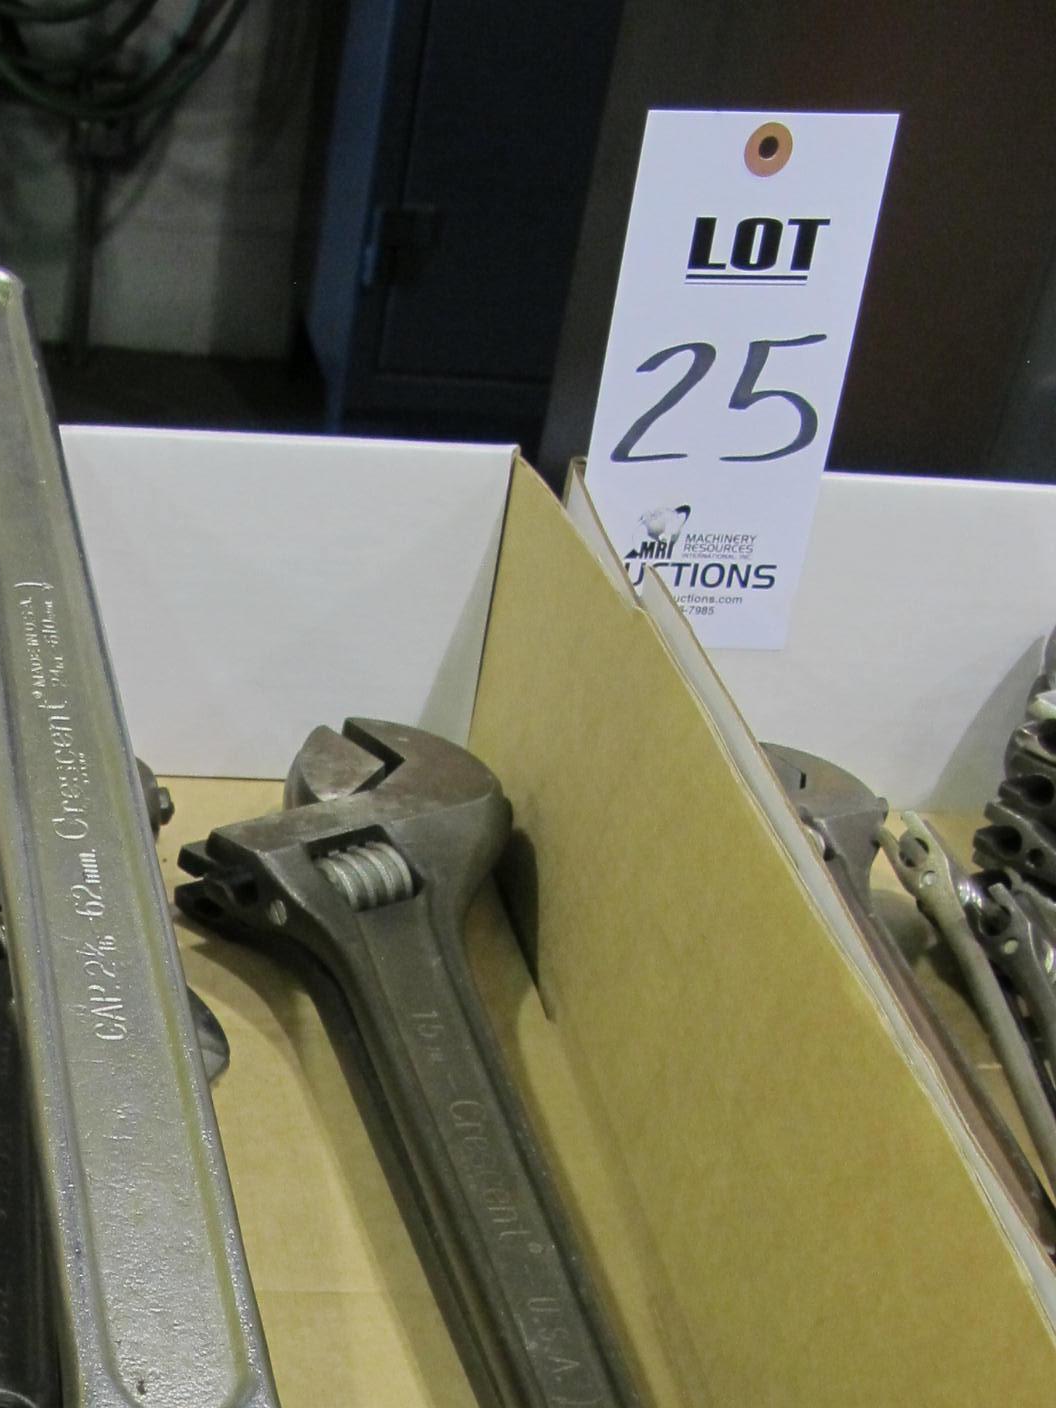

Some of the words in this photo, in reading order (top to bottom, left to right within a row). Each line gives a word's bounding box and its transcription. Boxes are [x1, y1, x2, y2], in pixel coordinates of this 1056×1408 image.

[687, 216, 831, 271] LOT
[610, 334, 828, 462] 25
[683, 543, 754, 553] RESOURCES
[685, 534, 757, 543] MACHINERY
[639, 541, 675, 560] MRI
